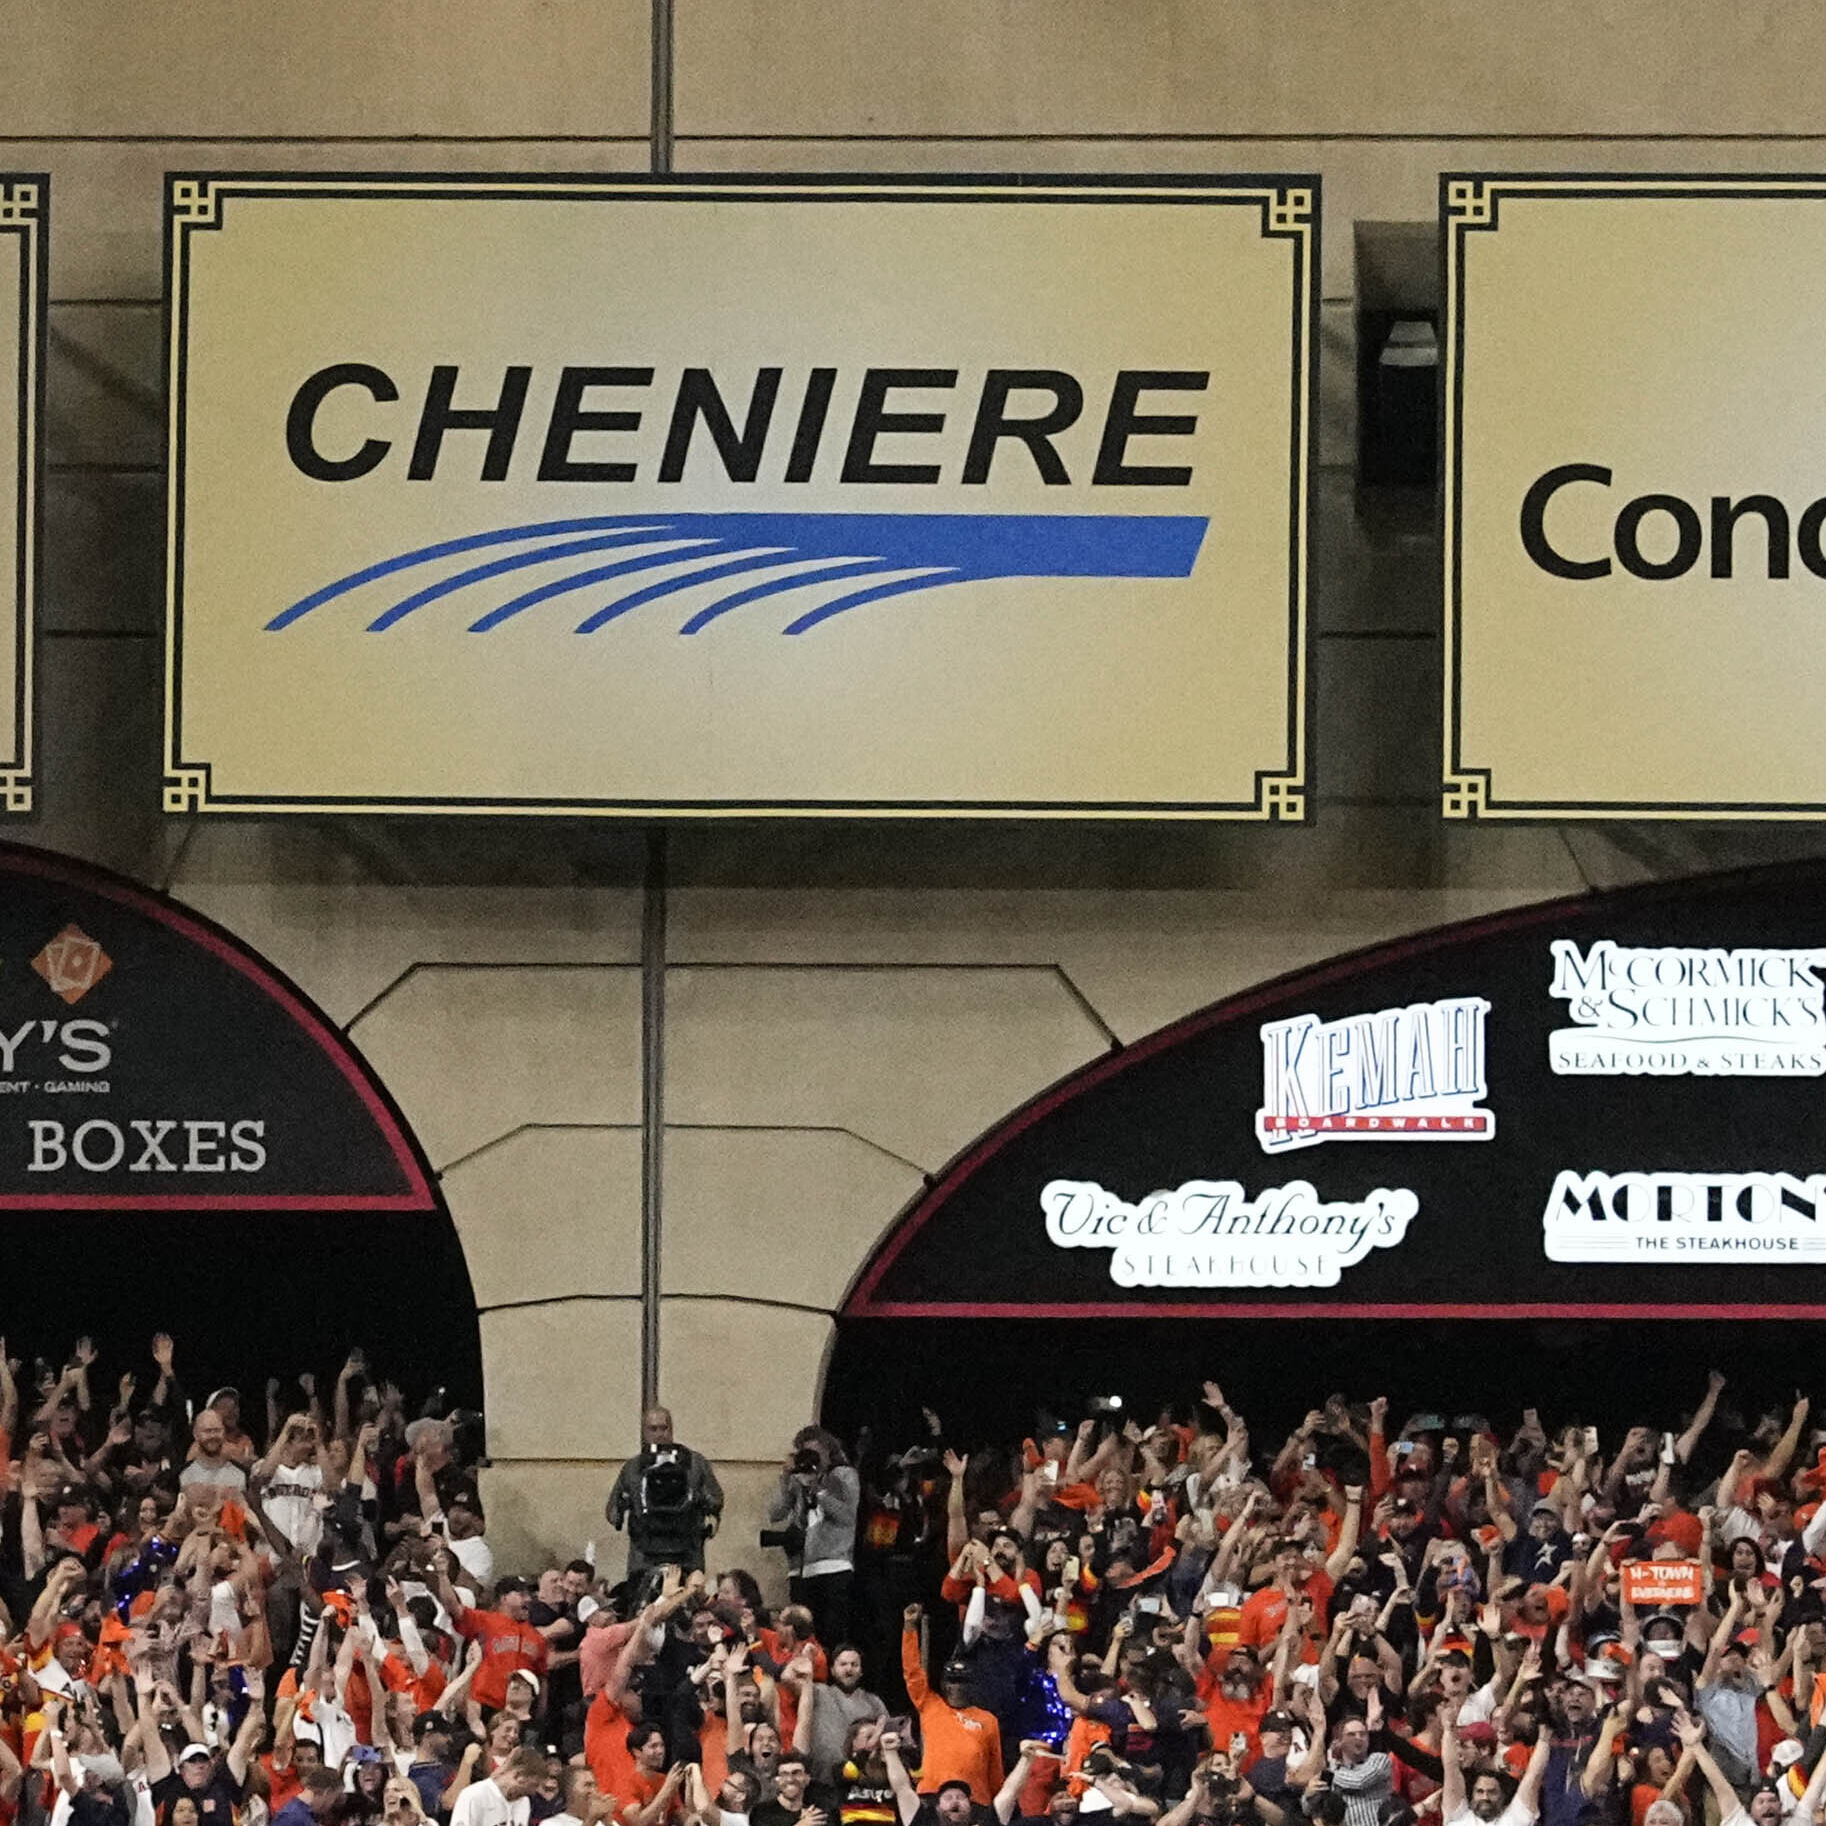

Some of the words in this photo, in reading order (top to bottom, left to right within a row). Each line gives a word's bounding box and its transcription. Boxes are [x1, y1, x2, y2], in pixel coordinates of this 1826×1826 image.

[286, 363, 1210, 487] CHENIERE
[1267, 1004, 1480, 1147] KEMAH
[1558, 1051, 1688, 1070] SEAFOOD
[1720, 1051, 1822, 1071] STEAKS
[27, 1119, 267, 1173] BOXES
[1274, 1116, 1477, 1129] BOARDWALK
[1052, 1191, 1128, 1237] Vic
[1135, 1199, 1169, 1237] &
[1180, 1191, 1395, 1255] Anthony's
[1635, 1236, 1670, 1251] THE
[1675, 1236, 1800, 1252] STEAKHOUSE
